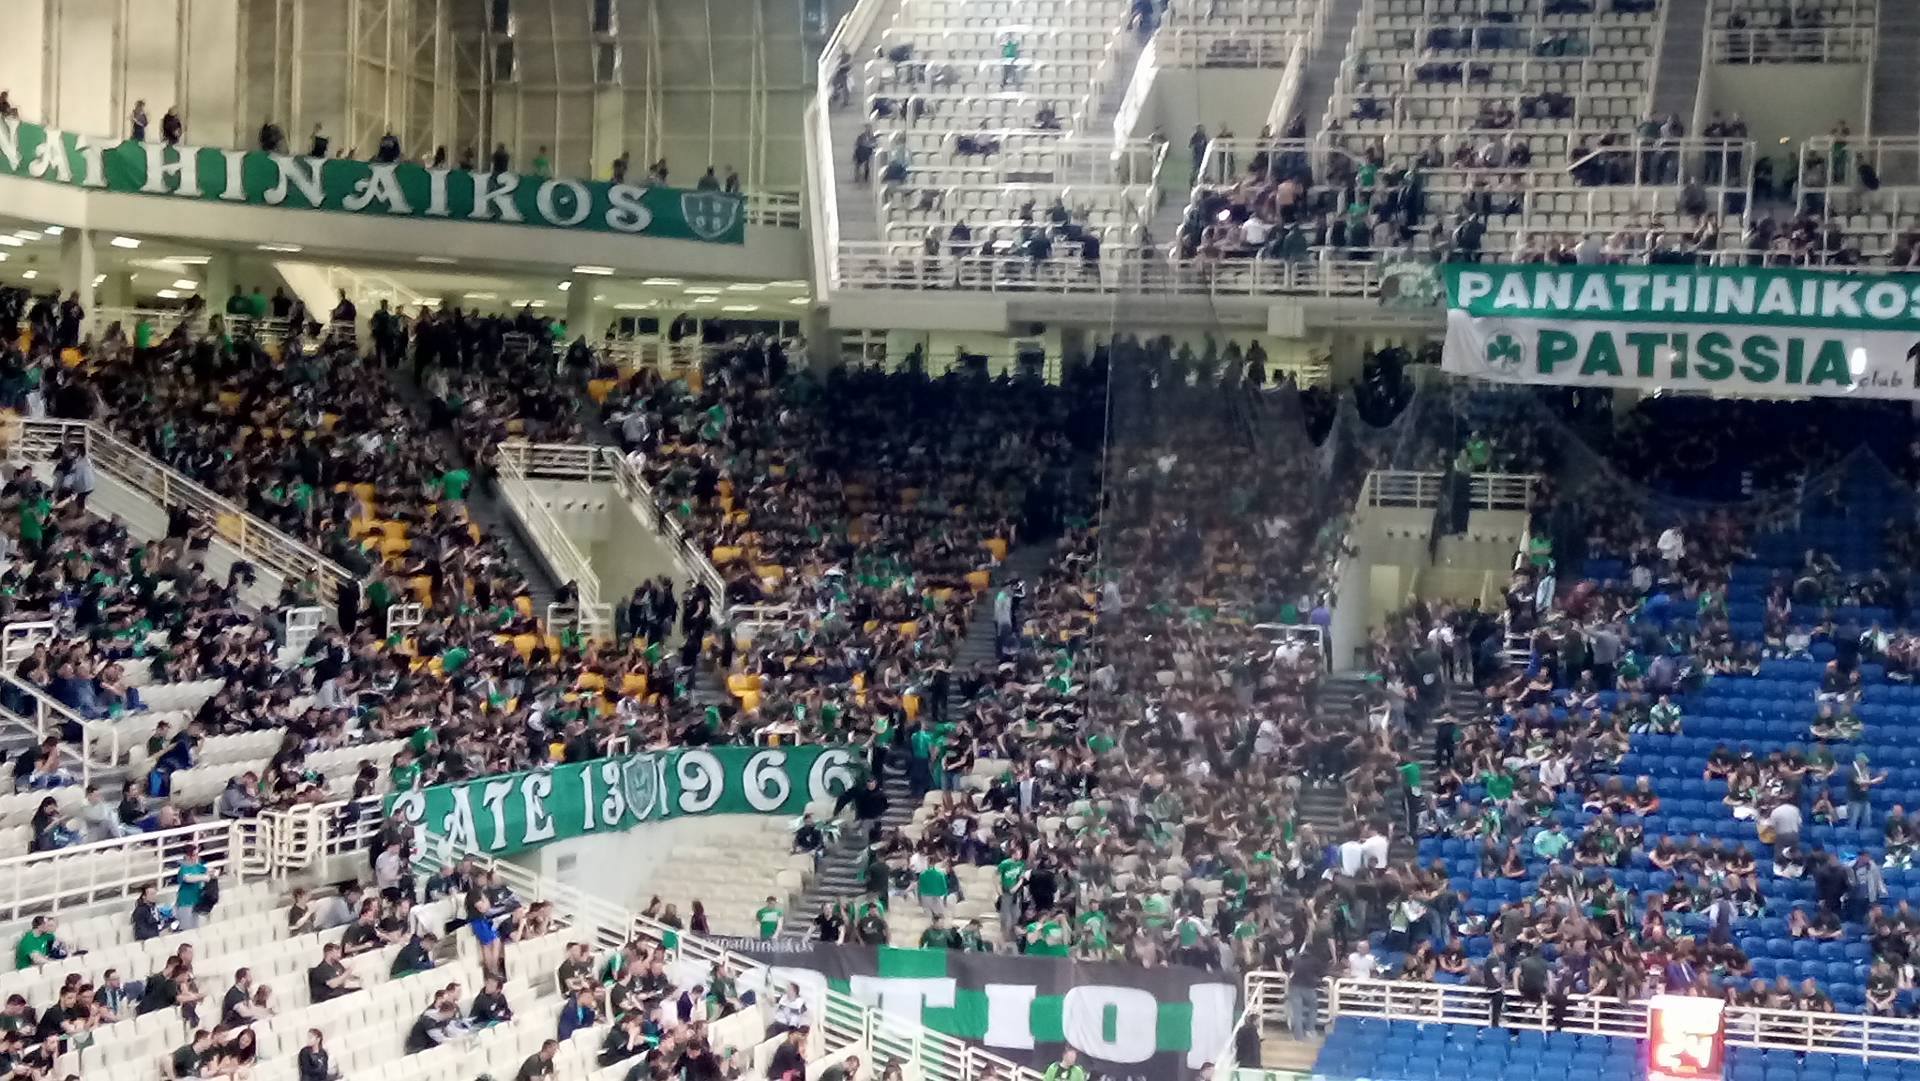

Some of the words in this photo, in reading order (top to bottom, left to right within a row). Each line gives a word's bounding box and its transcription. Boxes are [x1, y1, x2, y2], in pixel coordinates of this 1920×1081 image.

[1536, 329, 1854, 386] PATISSIA
[1858, 369, 1903, 387] club
[390, 773, 556, 865] GATE
[580, 760, 626, 830] 13
[656, 749, 855, 816] 1966
